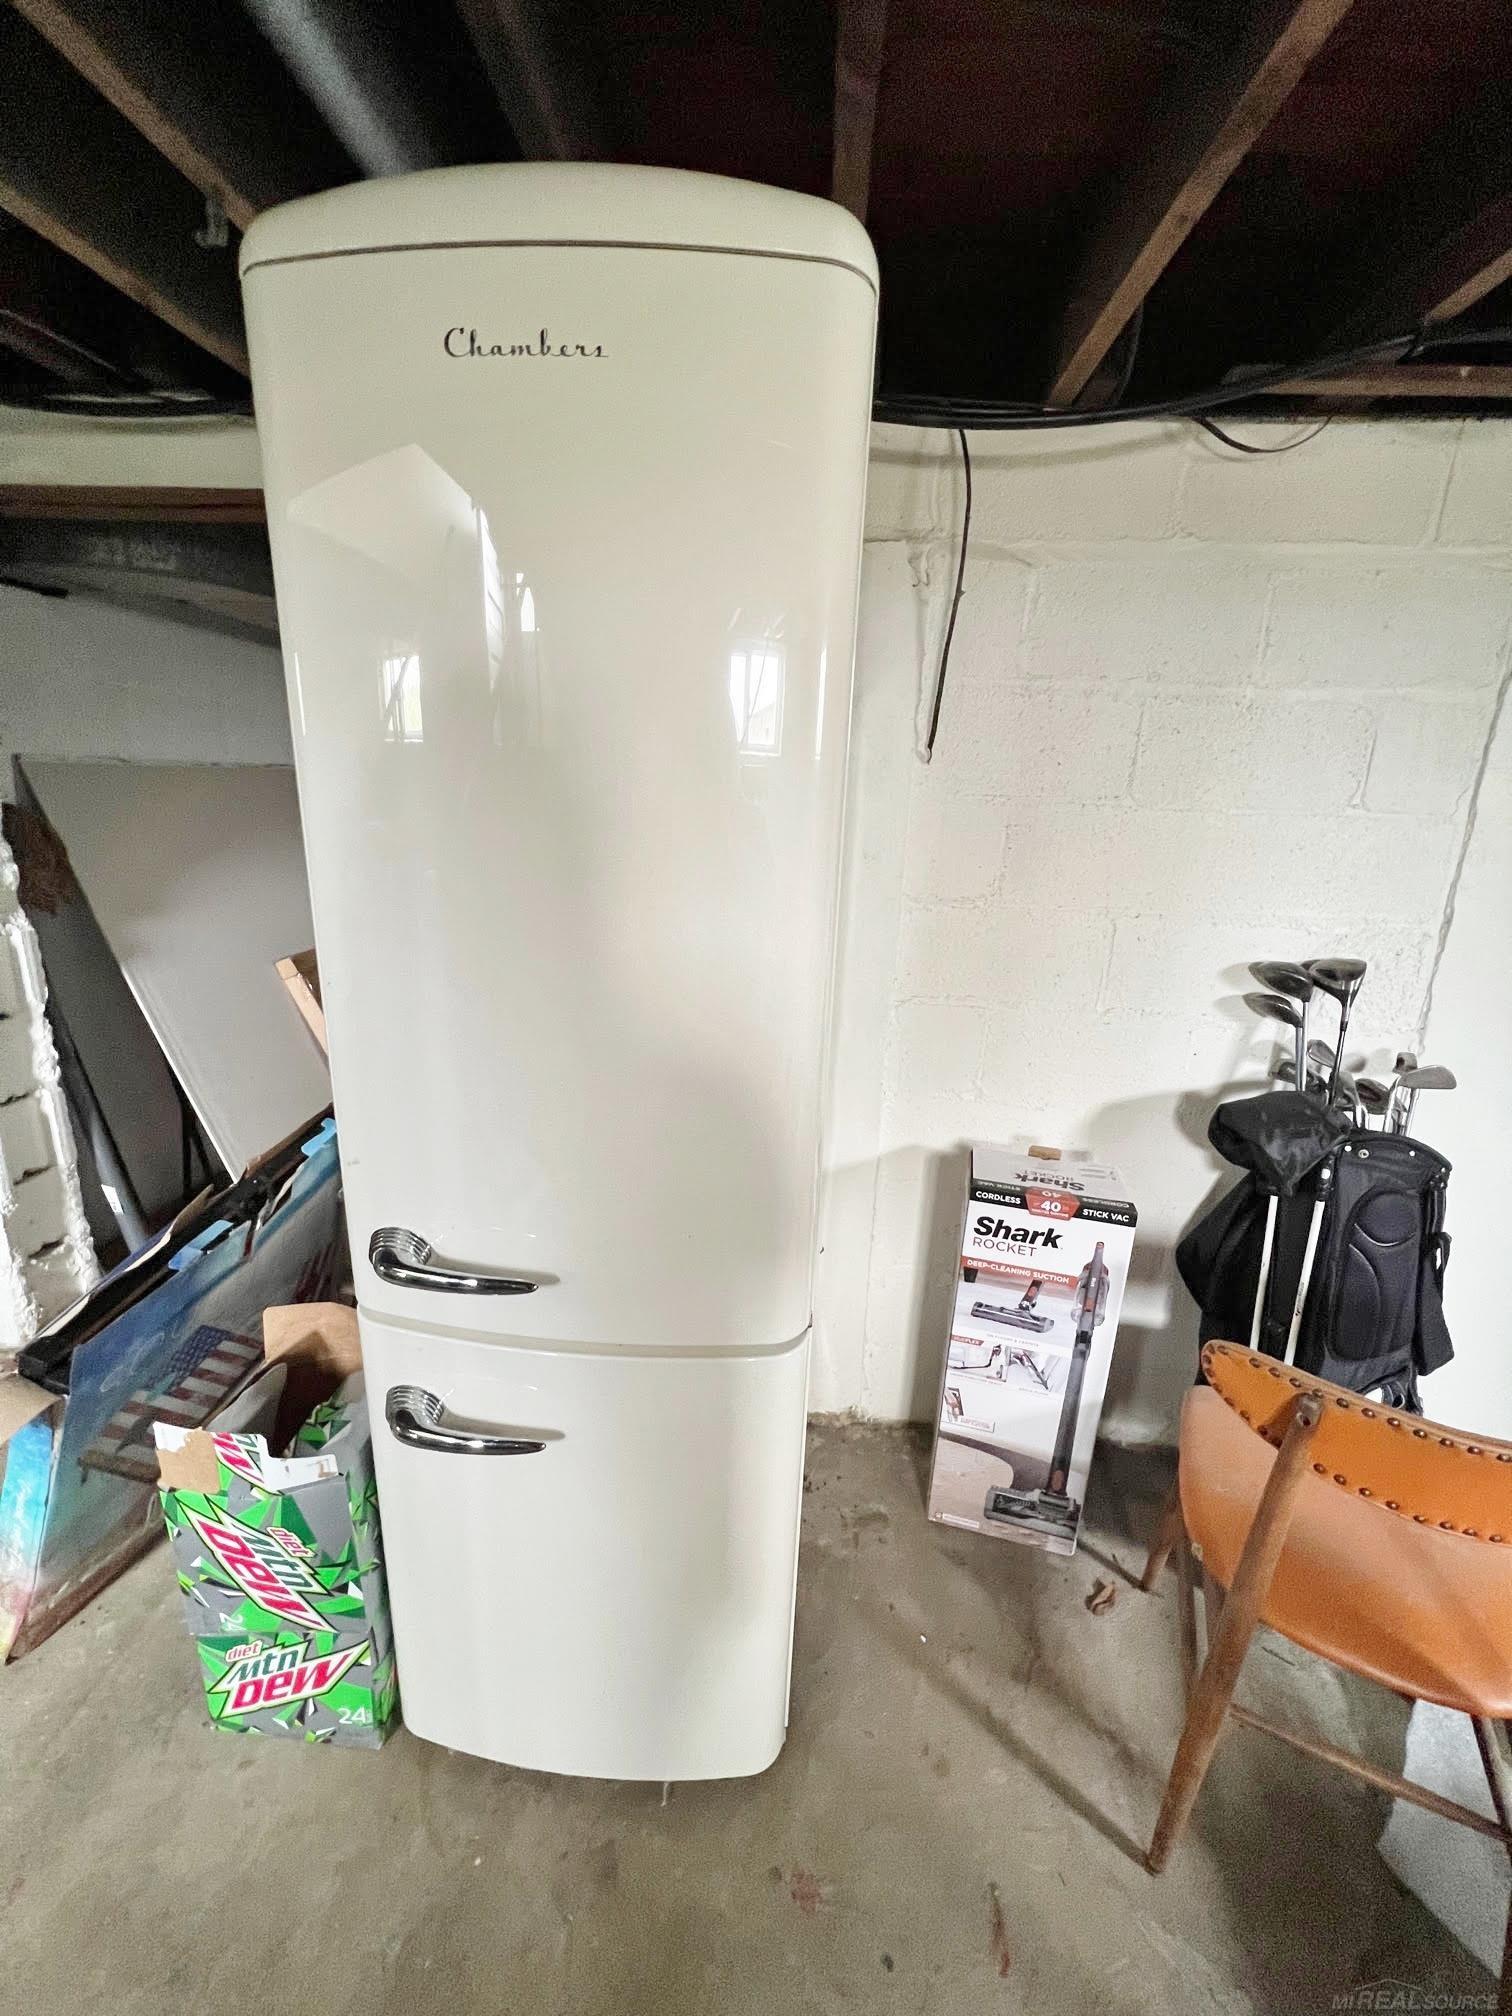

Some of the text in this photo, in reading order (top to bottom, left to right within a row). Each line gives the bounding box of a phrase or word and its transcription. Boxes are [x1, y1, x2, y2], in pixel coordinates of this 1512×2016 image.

[444, 327, 608, 358] Chambers
[1014, 1172, 1085, 1192] Shark
[975, 1190, 1021, 1205] CORDLESS
[1040, 1201, 1062, 1213] 40
[1082, 1208, 1130, 1222] STICK VAC
[973, 1216, 1063, 1249] Shark
[972, 1236, 1037, 1257] ROCKET
[967, 1259, 1070, 1284] DEEP-CLEANING SUCTION
[270, 1528, 309, 1556] diet
[227, 1643, 260, 1660] diet
[338, 1705, 367, 1725] 24
